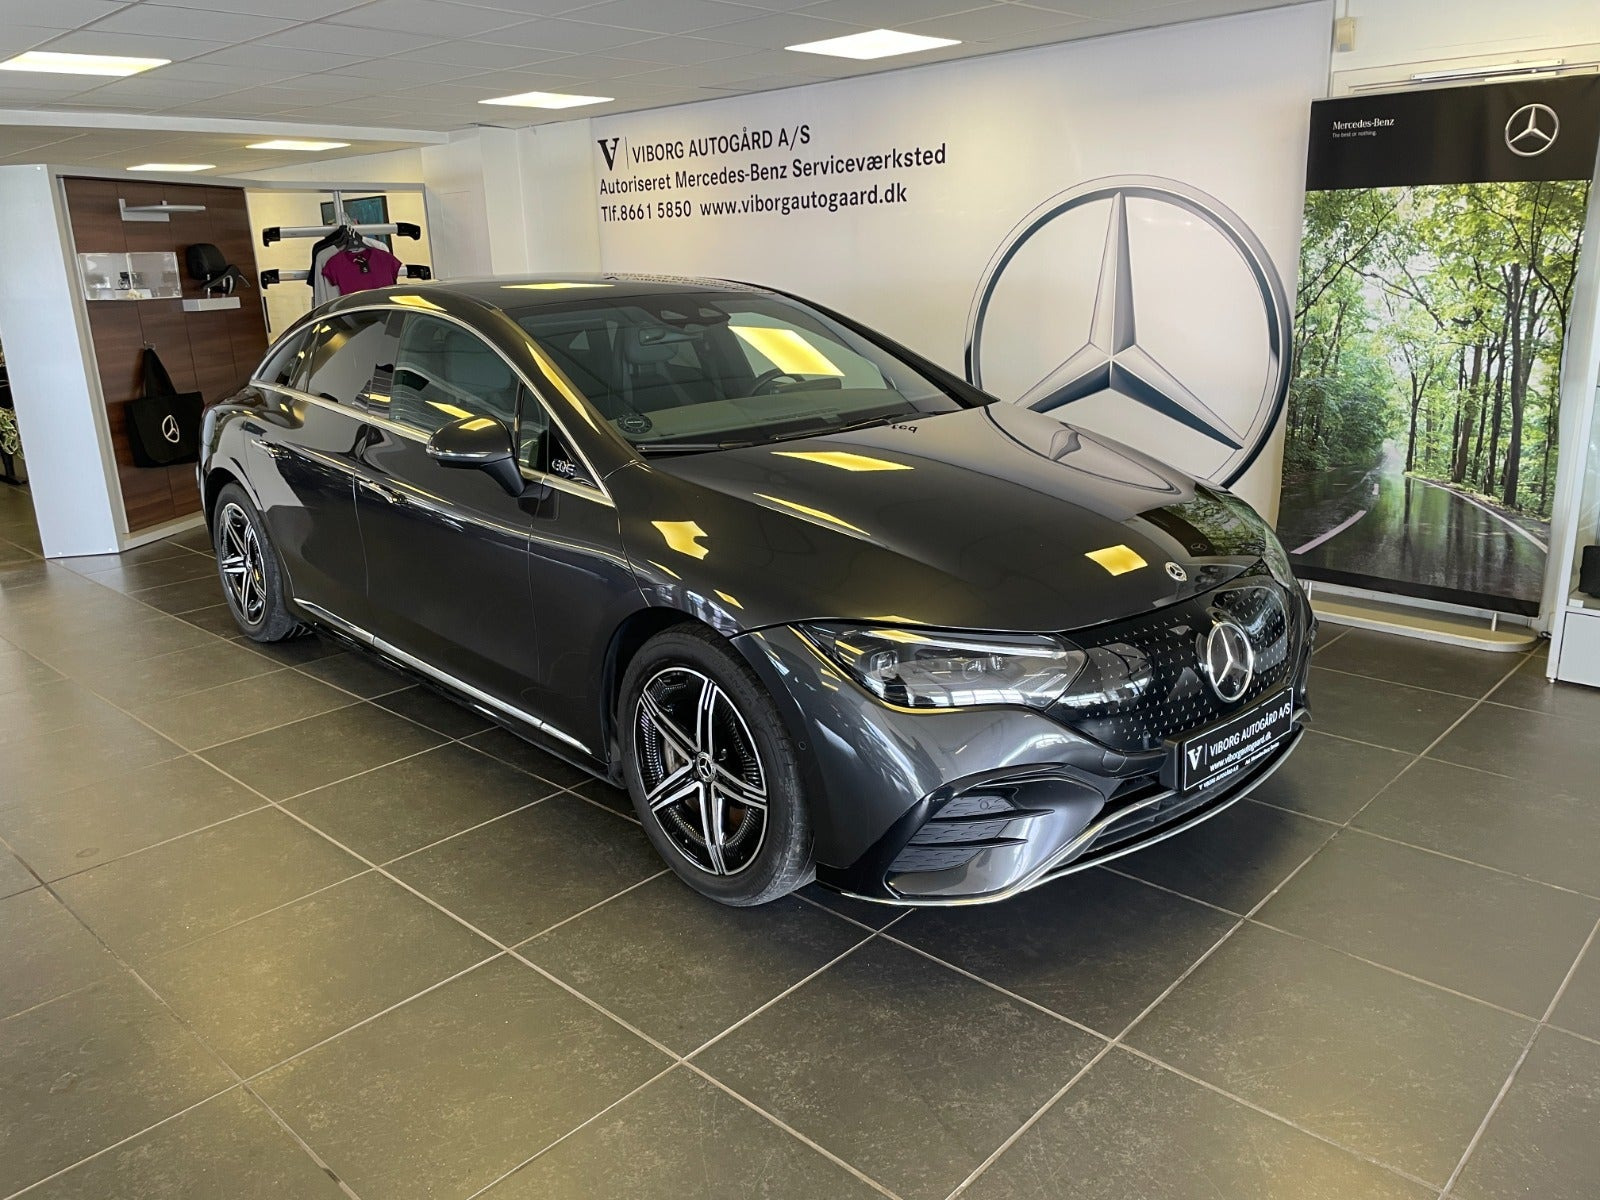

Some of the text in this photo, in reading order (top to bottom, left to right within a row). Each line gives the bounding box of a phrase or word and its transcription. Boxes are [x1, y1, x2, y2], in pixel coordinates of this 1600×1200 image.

[1332, 118, 1395, 130] Mercedes-Benz
[632, 141, 684, 164] VIBORG
[689, 126, 773, 157] AUTOGÅRD
[778, 125, 811, 151] A/S
[600, 143, 946, 195] Autoriseret Mercedes-Benz Serviceværksted
[657, 200, 692, 219] 5850
[700, 183, 907, 217] www.viborgautogaard.dk
[1209, 732, 1240, 757] VIBORG
[1241, 712, 1278, 742] AUTOGÅRD
[1278, 702, 1291, 719] A/S
